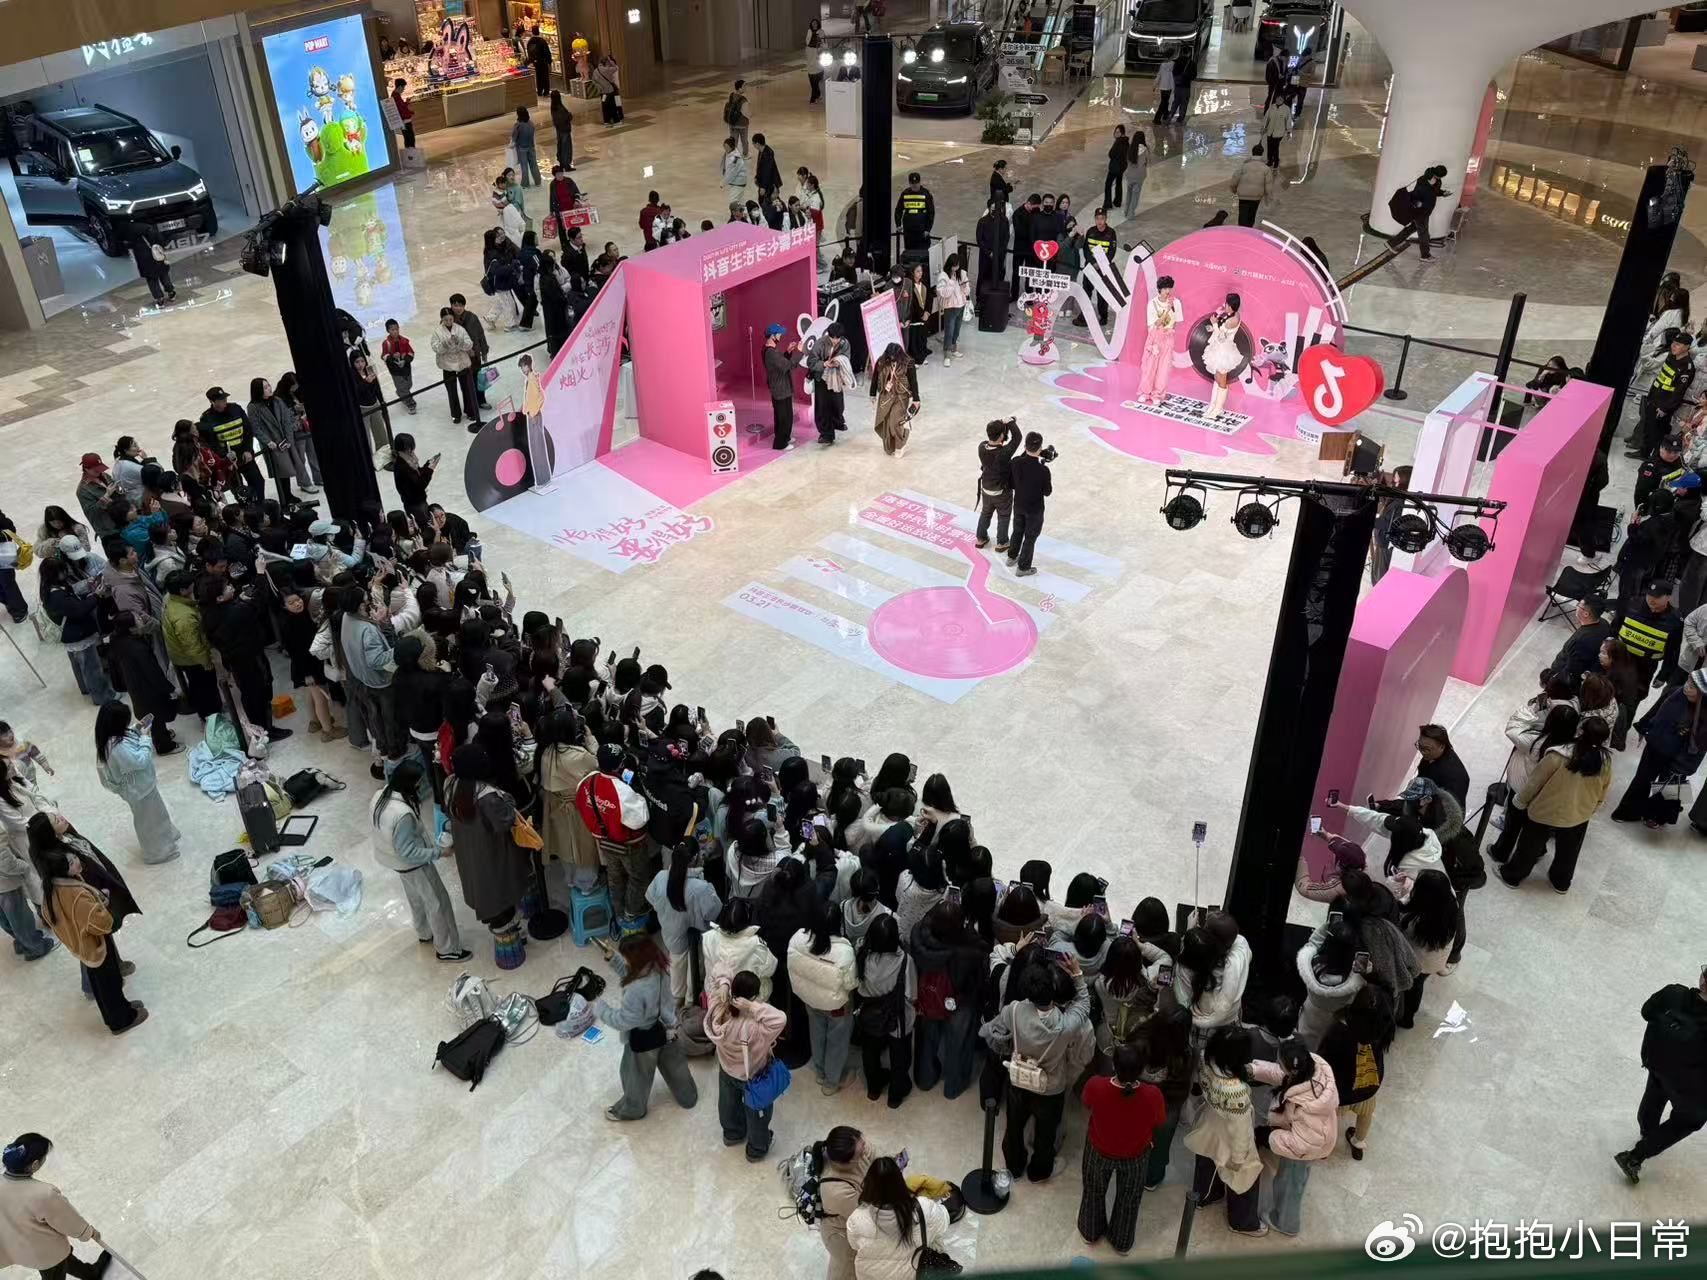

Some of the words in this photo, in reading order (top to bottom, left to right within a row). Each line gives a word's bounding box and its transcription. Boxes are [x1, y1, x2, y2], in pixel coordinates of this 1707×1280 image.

[314, 37, 328, 48] MART
[703, 222, 816, 282] 抖音生活长沙嘉年华
[1020, 267, 1050, 279] 抖音生活
[1032, 278, 1069, 289] 长沙嘉年华
